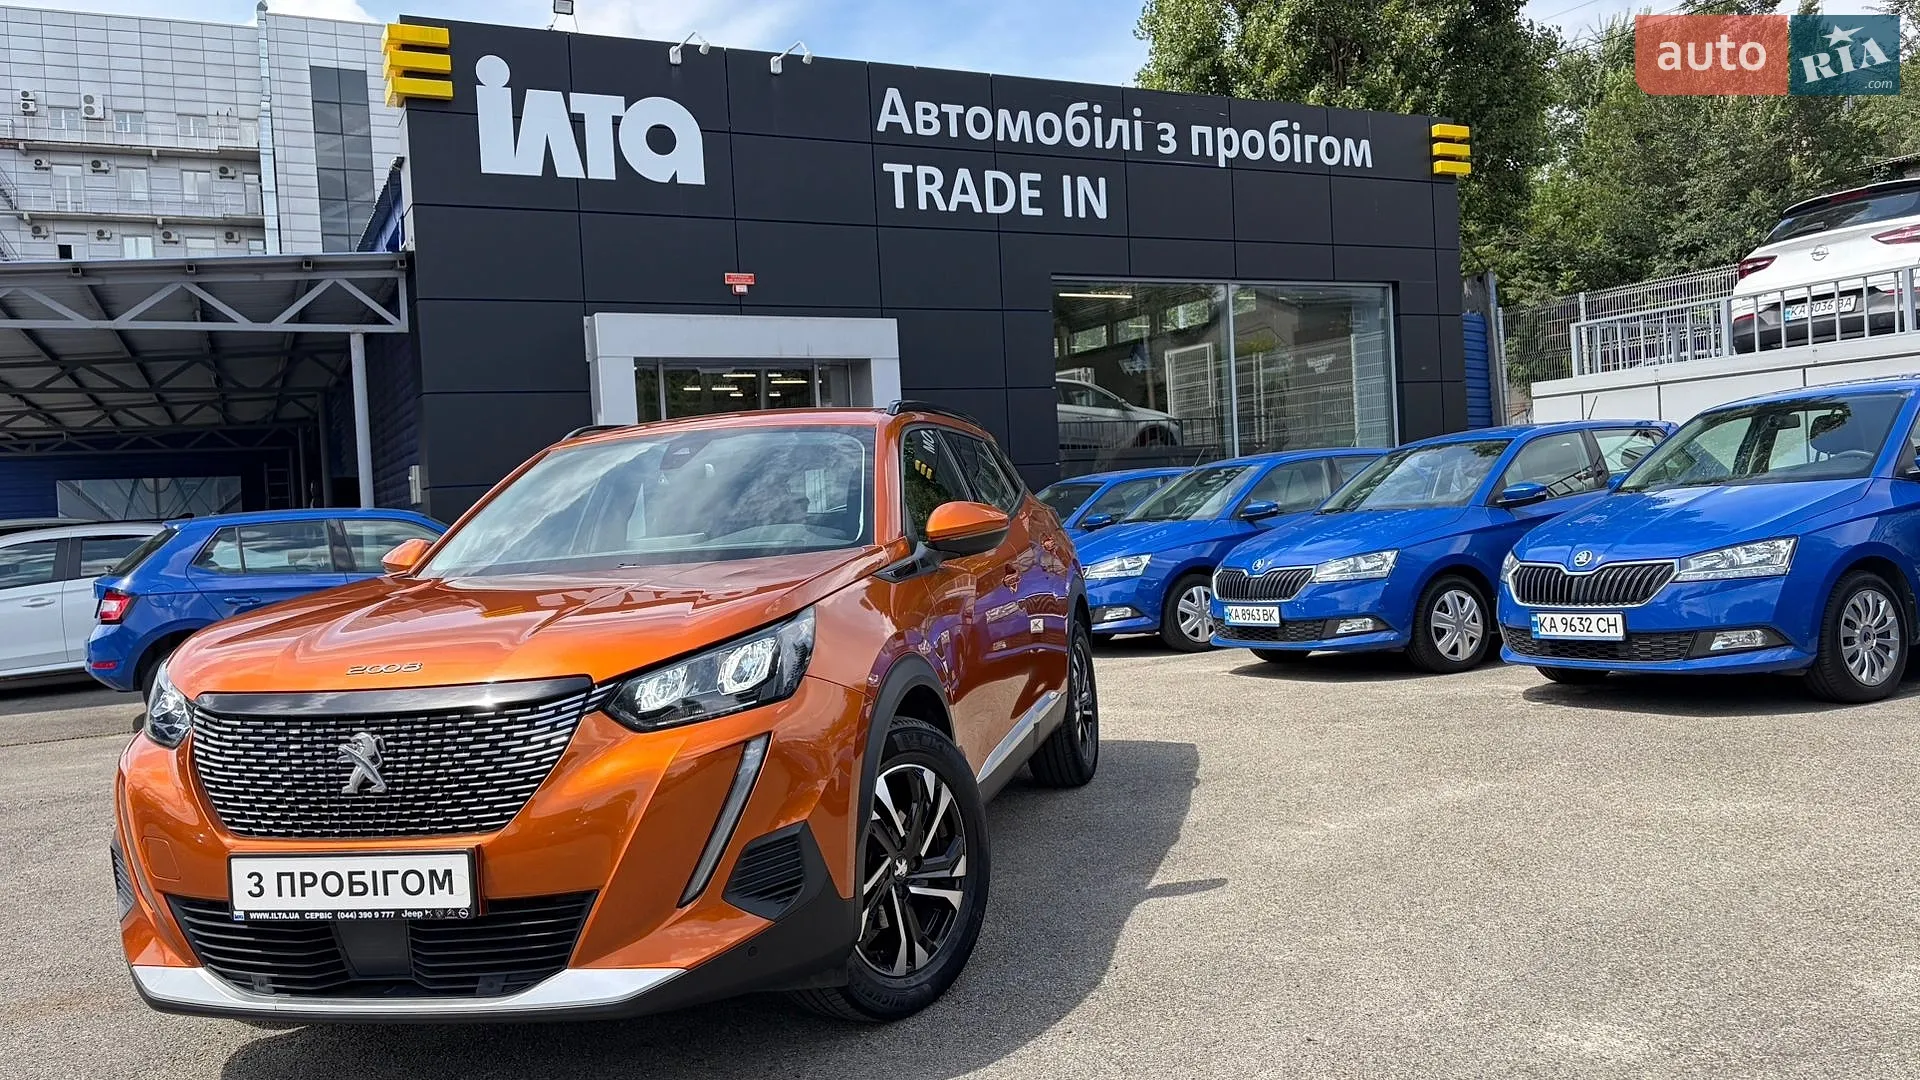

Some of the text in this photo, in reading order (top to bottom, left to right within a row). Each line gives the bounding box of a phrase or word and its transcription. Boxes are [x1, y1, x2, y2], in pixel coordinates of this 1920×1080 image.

[876, 87, 1373, 168] Автомобілі з пробігом
[882, 162, 1109, 220] TRADE IN
[1241, 608, 1261, 622] 8963
[1262, 609, 1277, 622] BK
[1538, 616, 1619, 634] KA 9632 CH
[346, 662, 423, 675] 2008
[276, 868, 455, 898] ПРОБІГОМ
[249, 912, 300, 920] WWW.ILTA.UA
[337, 911, 357, 919] (044)
[358, 911, 373, 919] 390
[380, 911, 395, 919] 777
[401, 909, 423, 919] Jeep
